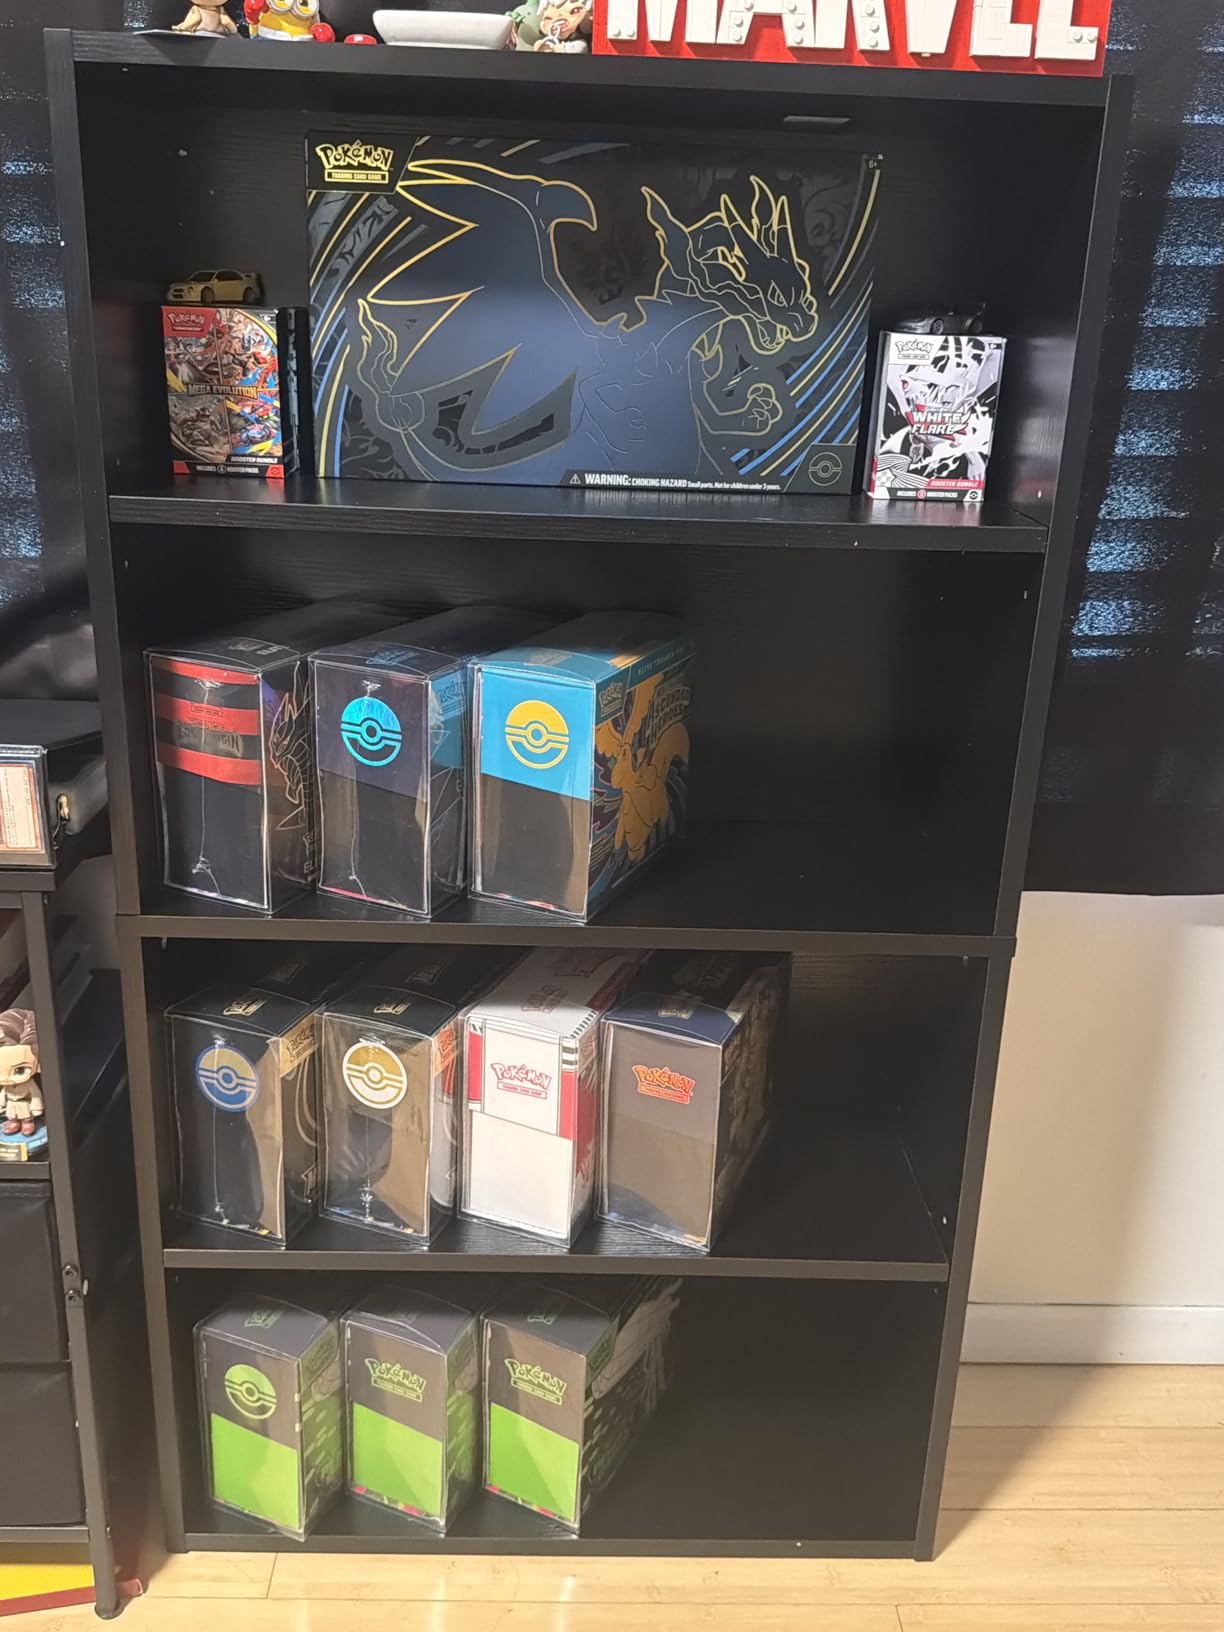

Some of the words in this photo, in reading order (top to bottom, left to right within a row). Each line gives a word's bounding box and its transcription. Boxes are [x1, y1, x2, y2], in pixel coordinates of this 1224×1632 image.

[187, 384, 211, 395] MEGA
[213, 384, 258, 400] EVOLUTION
[912, 411, 963, 424] WHITE
[910, 423, 957, 435] FLARE
[584, 473, 631, 486] WARNING:
[631, 477, 660, 487] CHOKING
[660, 478, 688, 488] HAZARD
